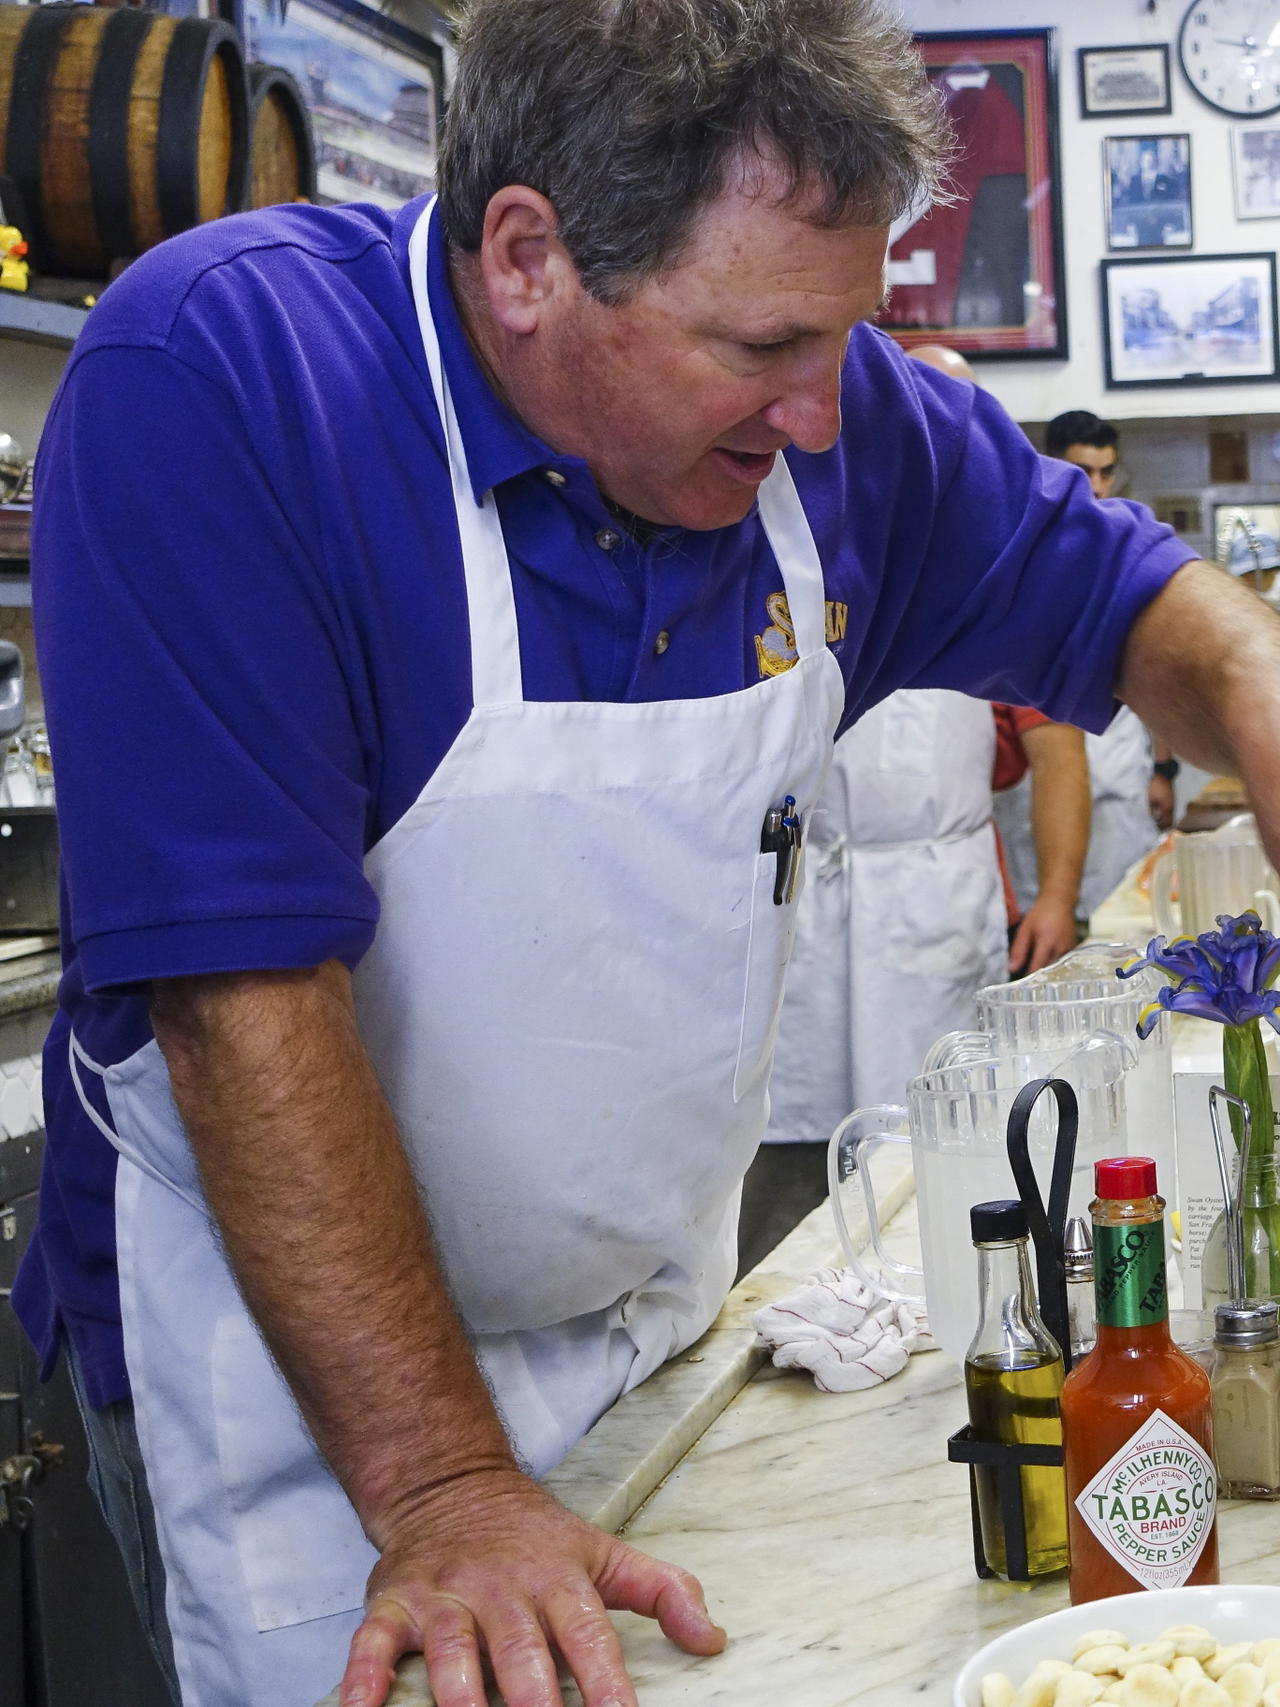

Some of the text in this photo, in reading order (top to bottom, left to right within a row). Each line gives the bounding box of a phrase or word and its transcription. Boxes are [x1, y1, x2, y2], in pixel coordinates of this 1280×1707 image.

[1097, 1230, 1145, 1312] ABASCO
[1135, 1441, 1155, 1452] MADE
[1138, 1470, 1184, 1487] AVERY ISLAND
[1091, 1475, 1214, 1521] TABASCO
[1140, 1516, 1187, 1534] BRAND
[1112, 1511, 1205, 1562] PEPPER SAUCE
[1150, 1532, 1164, 1540] EST.
